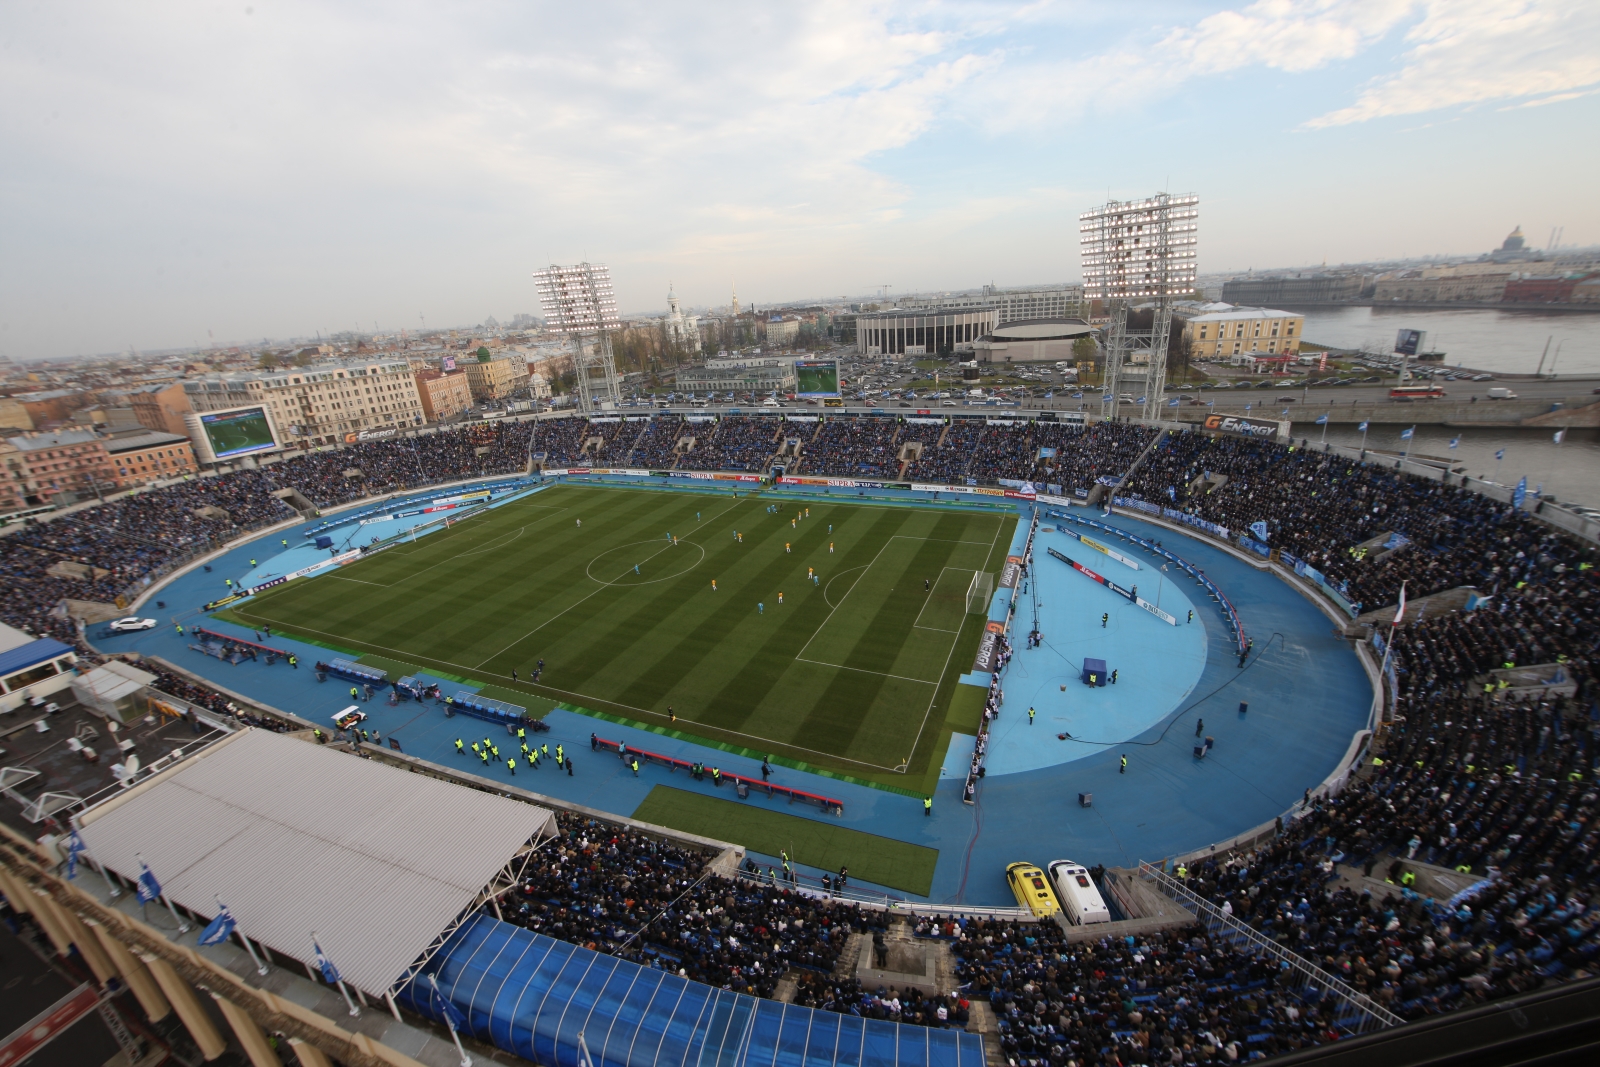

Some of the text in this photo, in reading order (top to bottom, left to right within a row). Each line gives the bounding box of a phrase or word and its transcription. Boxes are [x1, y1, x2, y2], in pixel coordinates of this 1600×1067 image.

[1205, 415, 1276, 436] G-ENRGY
[691, 472, 714, 480] SUPRA
[828, 479, 855, 487] SUPRA
[253, 577, 284, 592] Sealex
